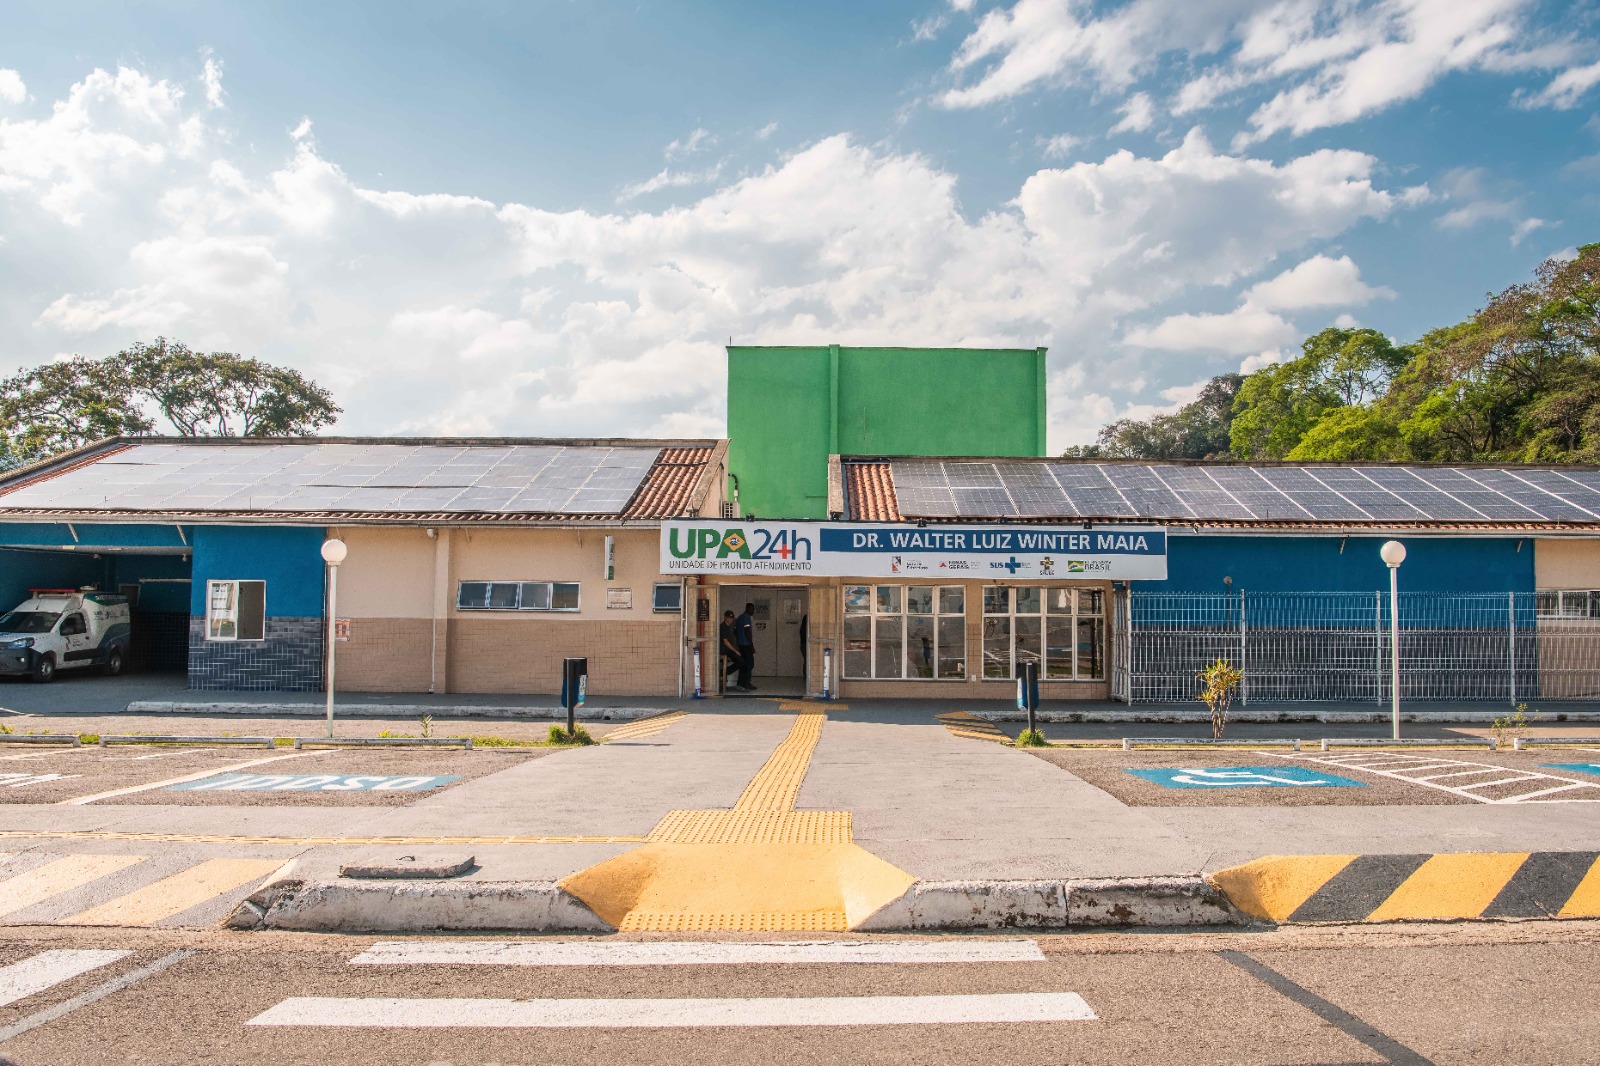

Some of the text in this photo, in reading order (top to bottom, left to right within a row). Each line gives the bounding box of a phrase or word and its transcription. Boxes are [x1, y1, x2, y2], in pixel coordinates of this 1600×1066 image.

[669, 528, 811, 560] UPA 24h
[852, 533, 1149, 551] DR. WALTER LUIZ WINTER MAIA
[669, 560, 812, 571] UNIDADE DE PRONTO ATENDIMENTO
[1084, 563, 1111, 571] BRASIL
[189, 775, 437, 790] IDOSO
